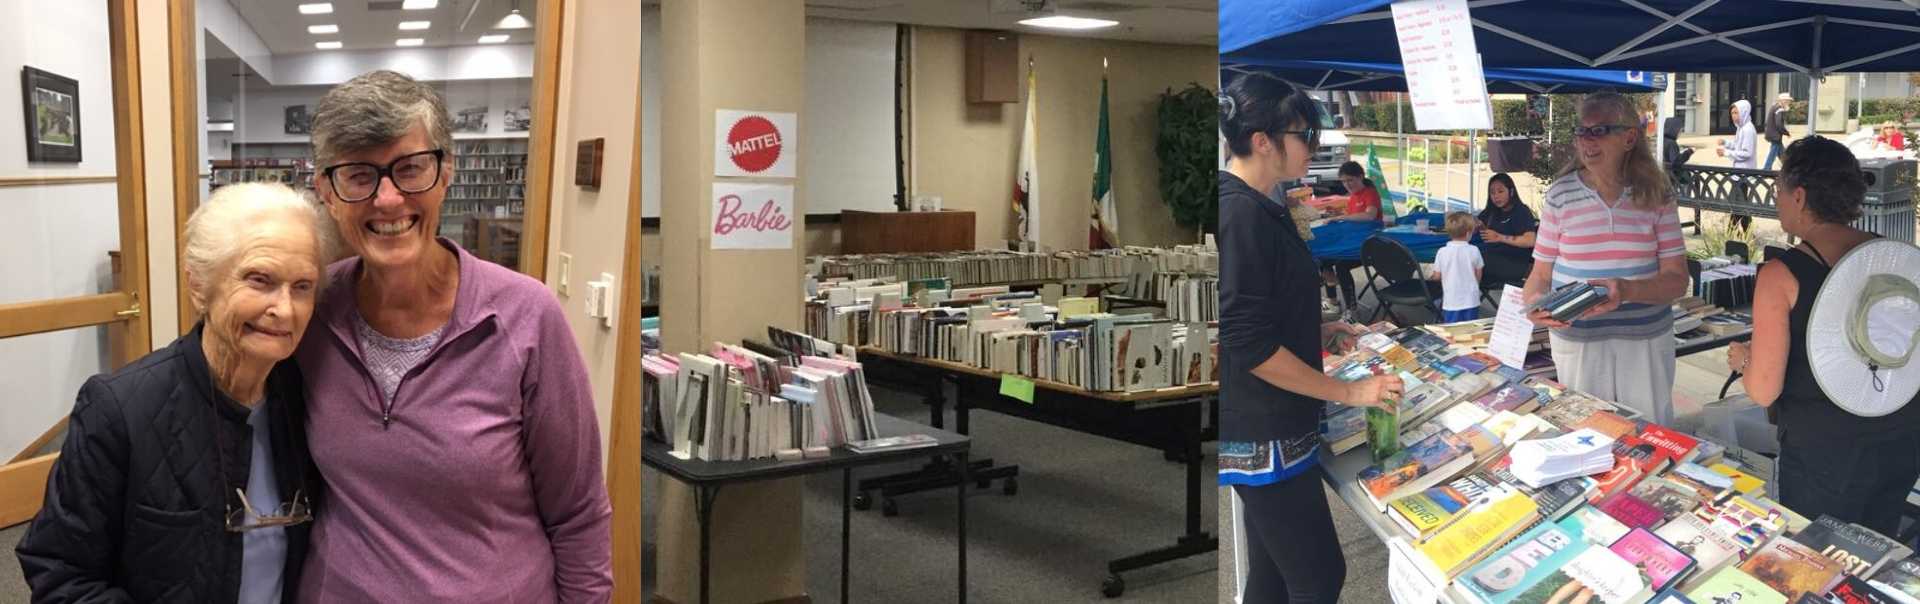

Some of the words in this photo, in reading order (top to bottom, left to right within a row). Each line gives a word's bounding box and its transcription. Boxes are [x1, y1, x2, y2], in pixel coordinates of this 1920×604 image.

[728, 132, 783, 157] MATTEL
[714, 194, 792, 235] Barbie
[1640, 431, 1690, 455] Unwitting
[1472, 528, 1572, 594] DEB
[1820, 544, 1872, 576] LOST
